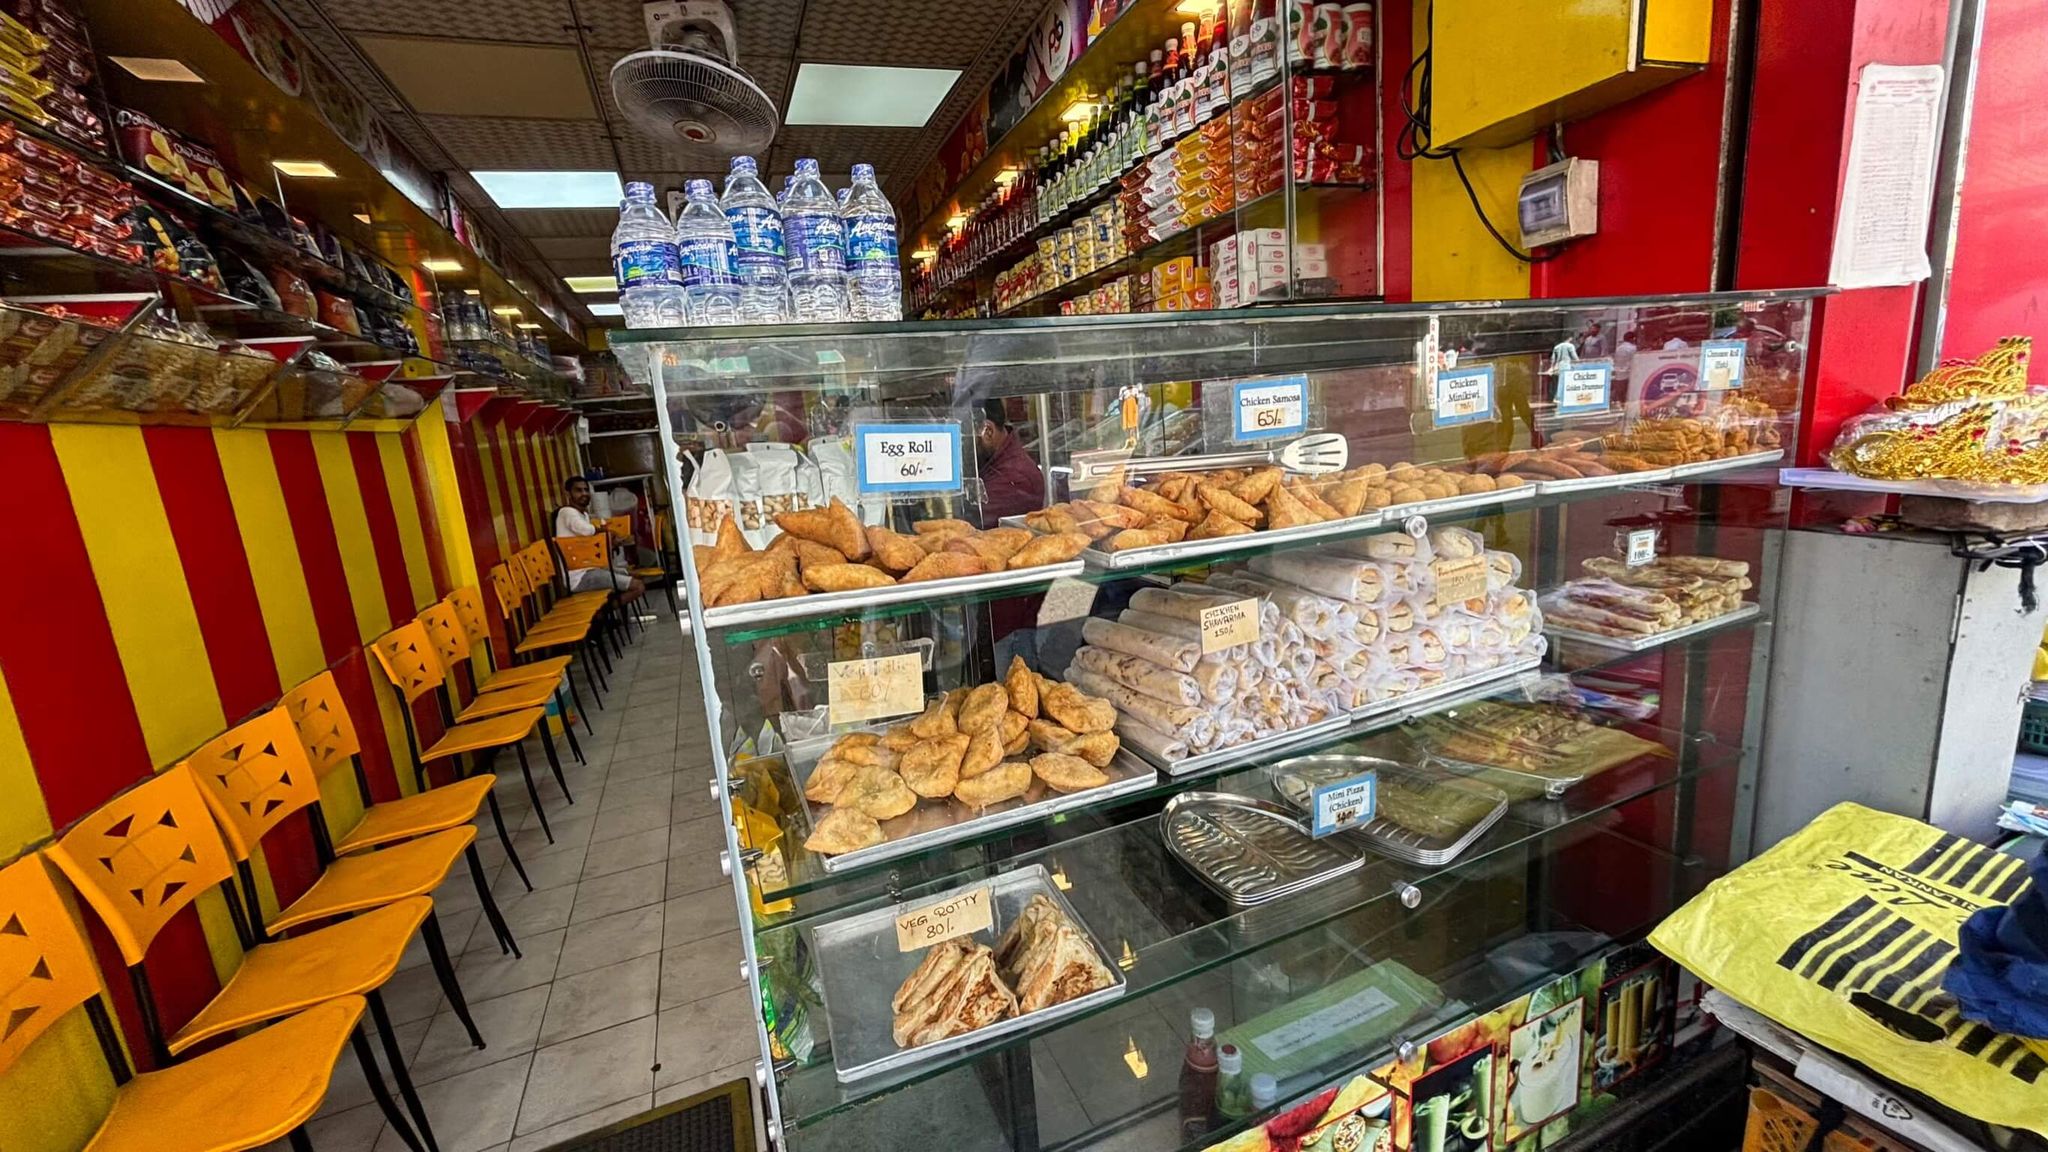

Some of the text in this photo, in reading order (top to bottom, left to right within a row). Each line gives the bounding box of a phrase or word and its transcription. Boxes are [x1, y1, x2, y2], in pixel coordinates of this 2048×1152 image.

[1449, 378, 1478, 390] Chicken
[1573, 372, 1597, 381] Chicken
[1240, 394, 1300, 407] Chicken Samosa
[880, 440, 933, 456] Egg Roll
[1328, 785, 1364, 802] Mini Pizza
[1329, 796, 1363, 813] (Chicken)
[1825, 859, 1949, 909] Line
[1879, 866, 1959, 906] LANKAN
[900, 894, 978, 931] VEG ROTTY
